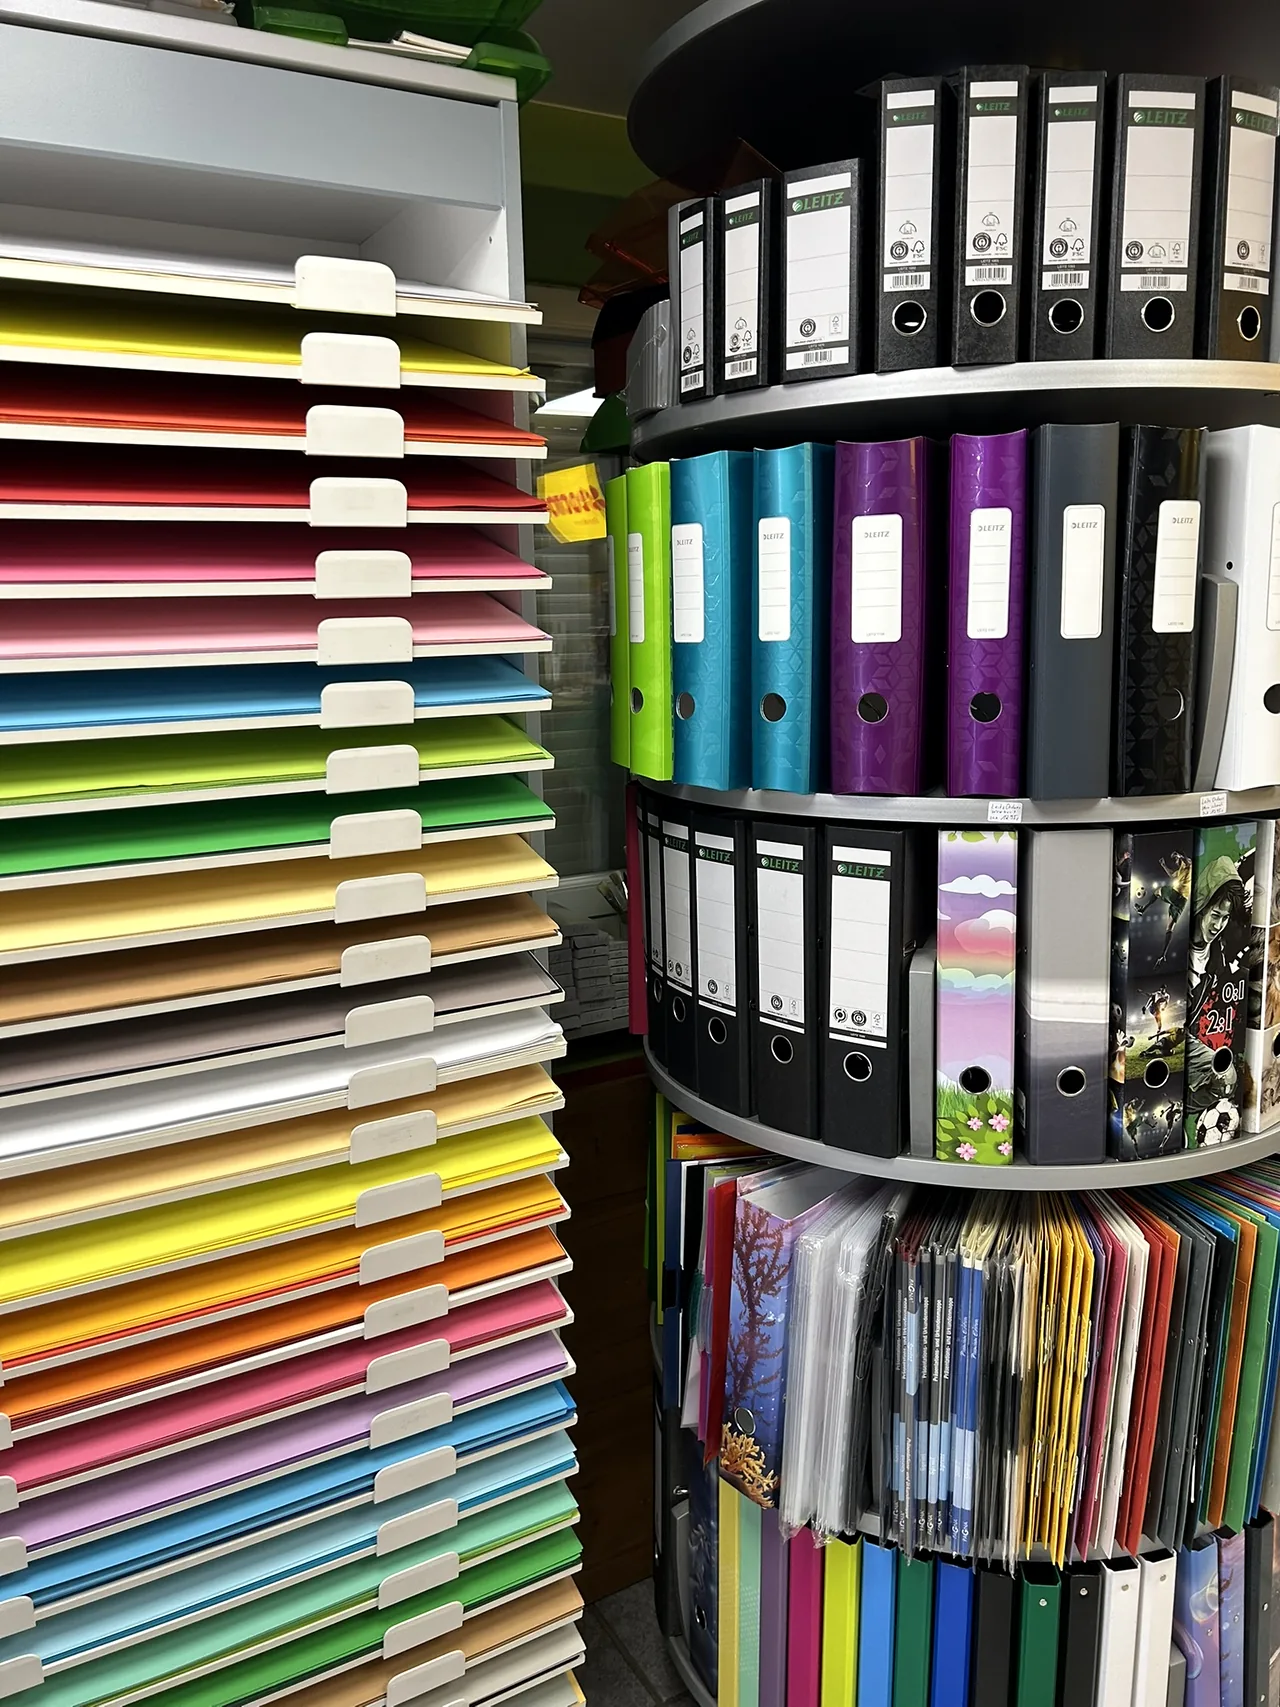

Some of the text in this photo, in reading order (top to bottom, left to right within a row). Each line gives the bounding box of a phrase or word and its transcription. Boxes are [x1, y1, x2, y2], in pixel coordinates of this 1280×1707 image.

[982, 101, 1011, 111] LEITZ
[1062, 107, 1089, 116] LEITZ
[899, 111, 927, 121] LEITZ
[1146, 110, 1189, 125] LEITZ
[1244, 113, 1273, 131] LEITZ
[803, 191, 845, 210] LEITZ
[734, 211, 754, 223] LEITZ
[1076, 521, 1098, 529] LEITZ
[669, 837, 686, 850] LEITZ
[706, 849, 731, 863] LEITZ
[769, 858, 800, 872] LEITZ
[847, 865, 886, 878] LEITZ
[1206, 1006, 1233, 1035] 2:1
[943, 1346, 951, 1379] Präsentations-
[918, 1509, 926, 1531] PAGNA
[926, 1513, 934, 1536] PAGNA
[951, 1519, 959, 1540] PAGNA
[961, 1521, 969, 1543] PAGNA
